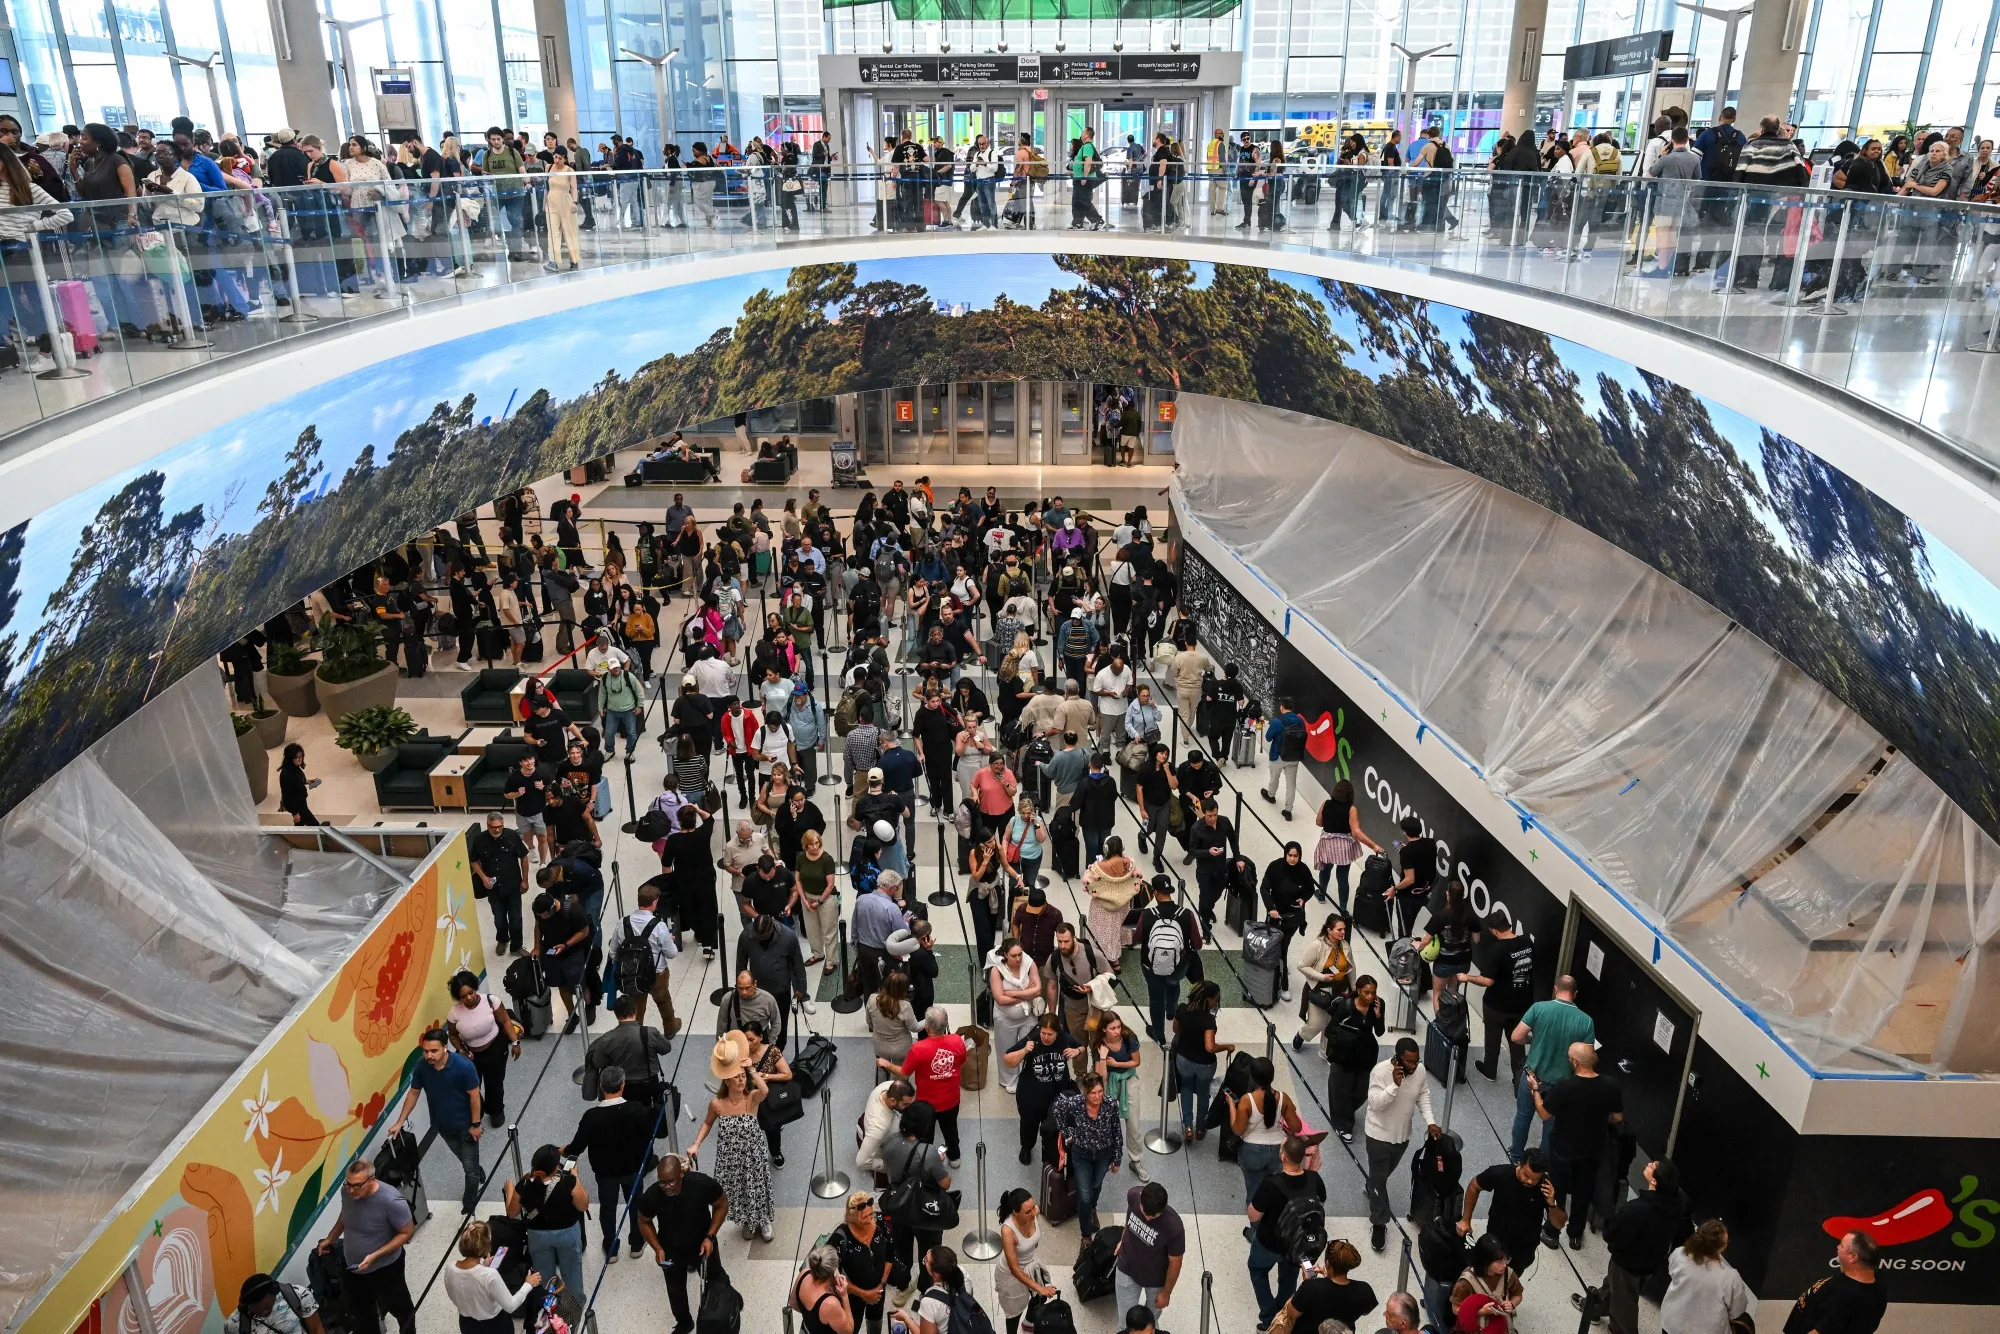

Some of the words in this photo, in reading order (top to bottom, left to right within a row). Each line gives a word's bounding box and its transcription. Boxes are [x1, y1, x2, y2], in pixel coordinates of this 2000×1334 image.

[492, 160, 506, 169] CAT
[902, 407, 908, 419] E
[1164, 408, 1170, 420] E
[1128, 1219, 1154, 1246] PROTOCOL
[1828, 1258, 1906, 1270] CNG
[1910, 1260, 1966, 1271] SOON
